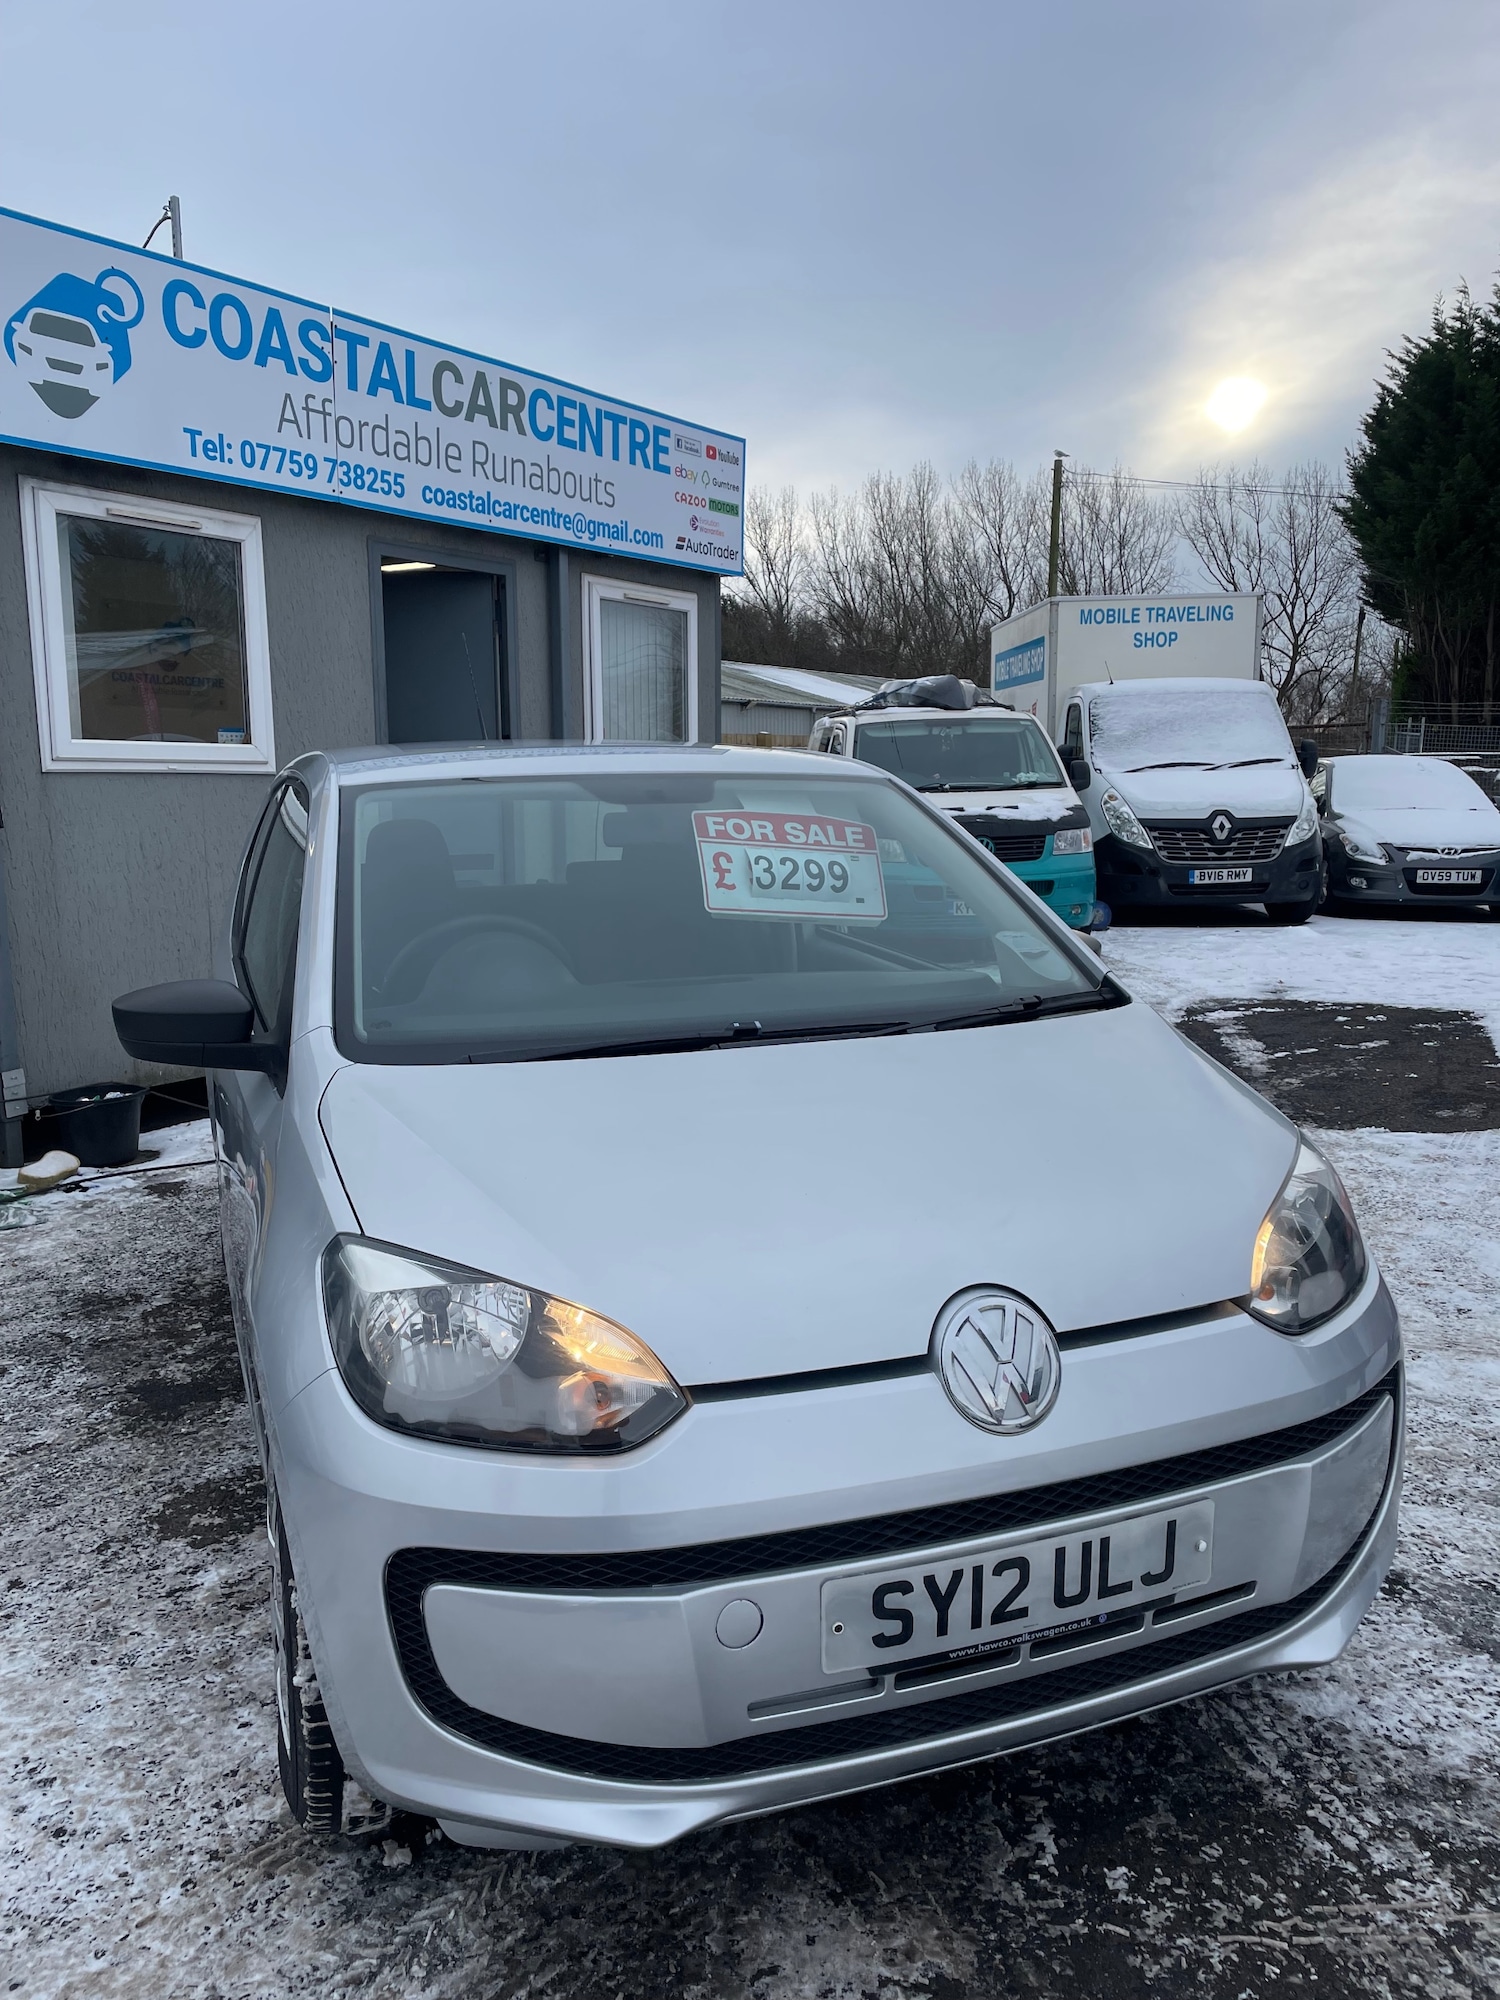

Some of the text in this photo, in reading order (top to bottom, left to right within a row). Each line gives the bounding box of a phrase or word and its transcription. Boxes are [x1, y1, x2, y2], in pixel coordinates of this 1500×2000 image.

[162, 279, 671, 475] COASTALCARCENTRE
[277, 392, 616, 508] Affordable Runabouts
[718, 448, 740, 466] YouTube
[183, 427, 405, 498] Tel: 07759 738255
[675, 464, 698, 484] ebay
[712, 477, 740, 492] Gumtree
[675, 491, 706, 508] CAZOO
[422, 484, 664, 549] coastalcarcentre@gmail.com
[685, 538, 739, 560] AutoTrader
[1080, 604, 1234, 625] MOBILE TRAVELING
[1133, 631, 1178, 648] SHOP
[705, 816, 865, 848] FOR SALE
[712, 851, 849, 894] £ 3299
[1199, 869, 1248, 881] BV16 RMY
[1422, 871, 1477, 881] OV59 TUW
[871, 1519, 1177, 1649] SY12 ULJ
[949, 1618, 1092, 1660] www.hawco.volkswagen.co.uk
